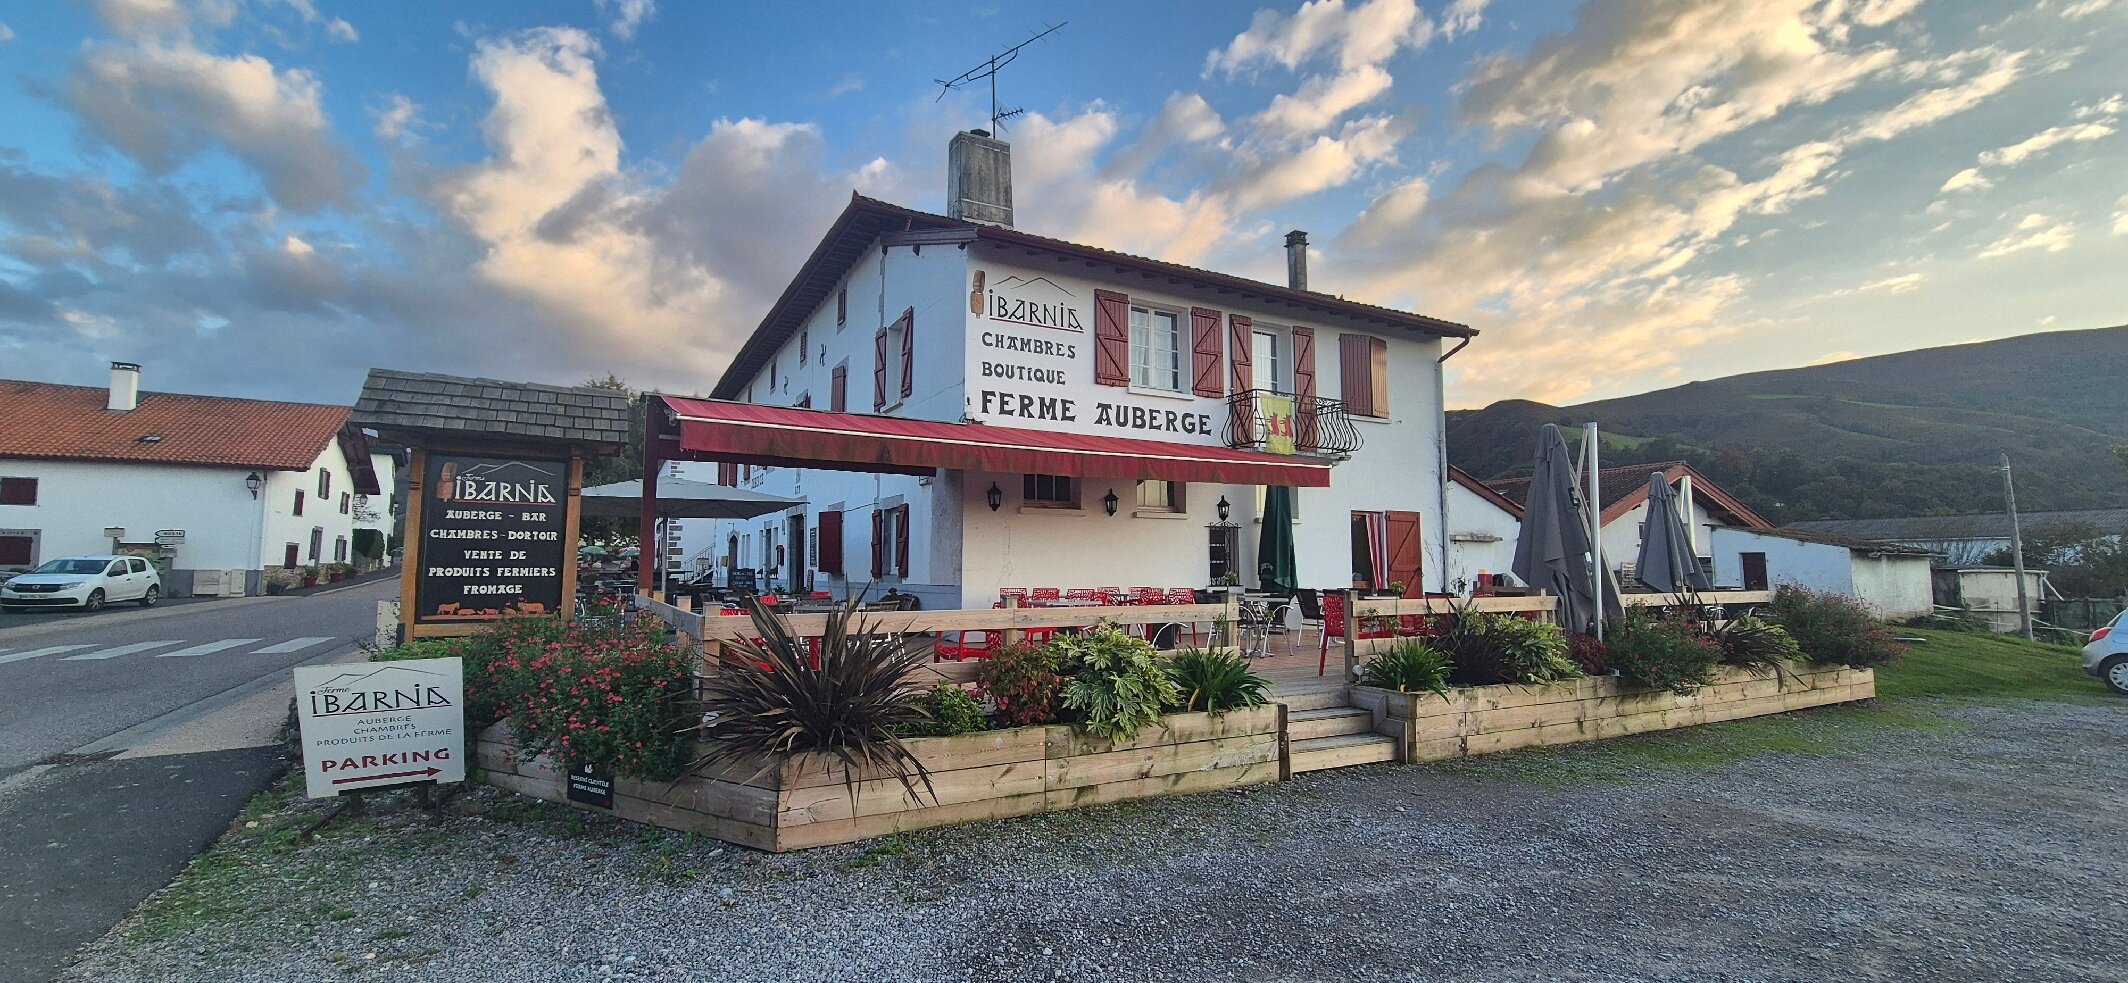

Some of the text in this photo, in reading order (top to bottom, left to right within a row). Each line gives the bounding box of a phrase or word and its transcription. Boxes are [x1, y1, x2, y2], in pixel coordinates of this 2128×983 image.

[981, 331, 1076, 360] CHAMBRES
[981, 361, 1066, 385] BOUTIQUE
[981, 390, 1212, 436] FERME AUBERGE
[445, 509, 503, 520] AUBERGE
[521, 512, 547, 522] BAR
[463, 550, 527, 560] VENTE DE
[428, 567, 556, 577] PRODUITS FERMIERS
[463, 584, 523, 595] FROMAGE
[317, 686, 351, 696] Ferme
[357, 715, 412, 726] AUBERGE
[353, 723, 416, 735] CHAMBRES
[316, 735, 375, 746] PRODUITS
[414, 728, 452, 738] FERME
[321, 748, 450, 773] PARKING
